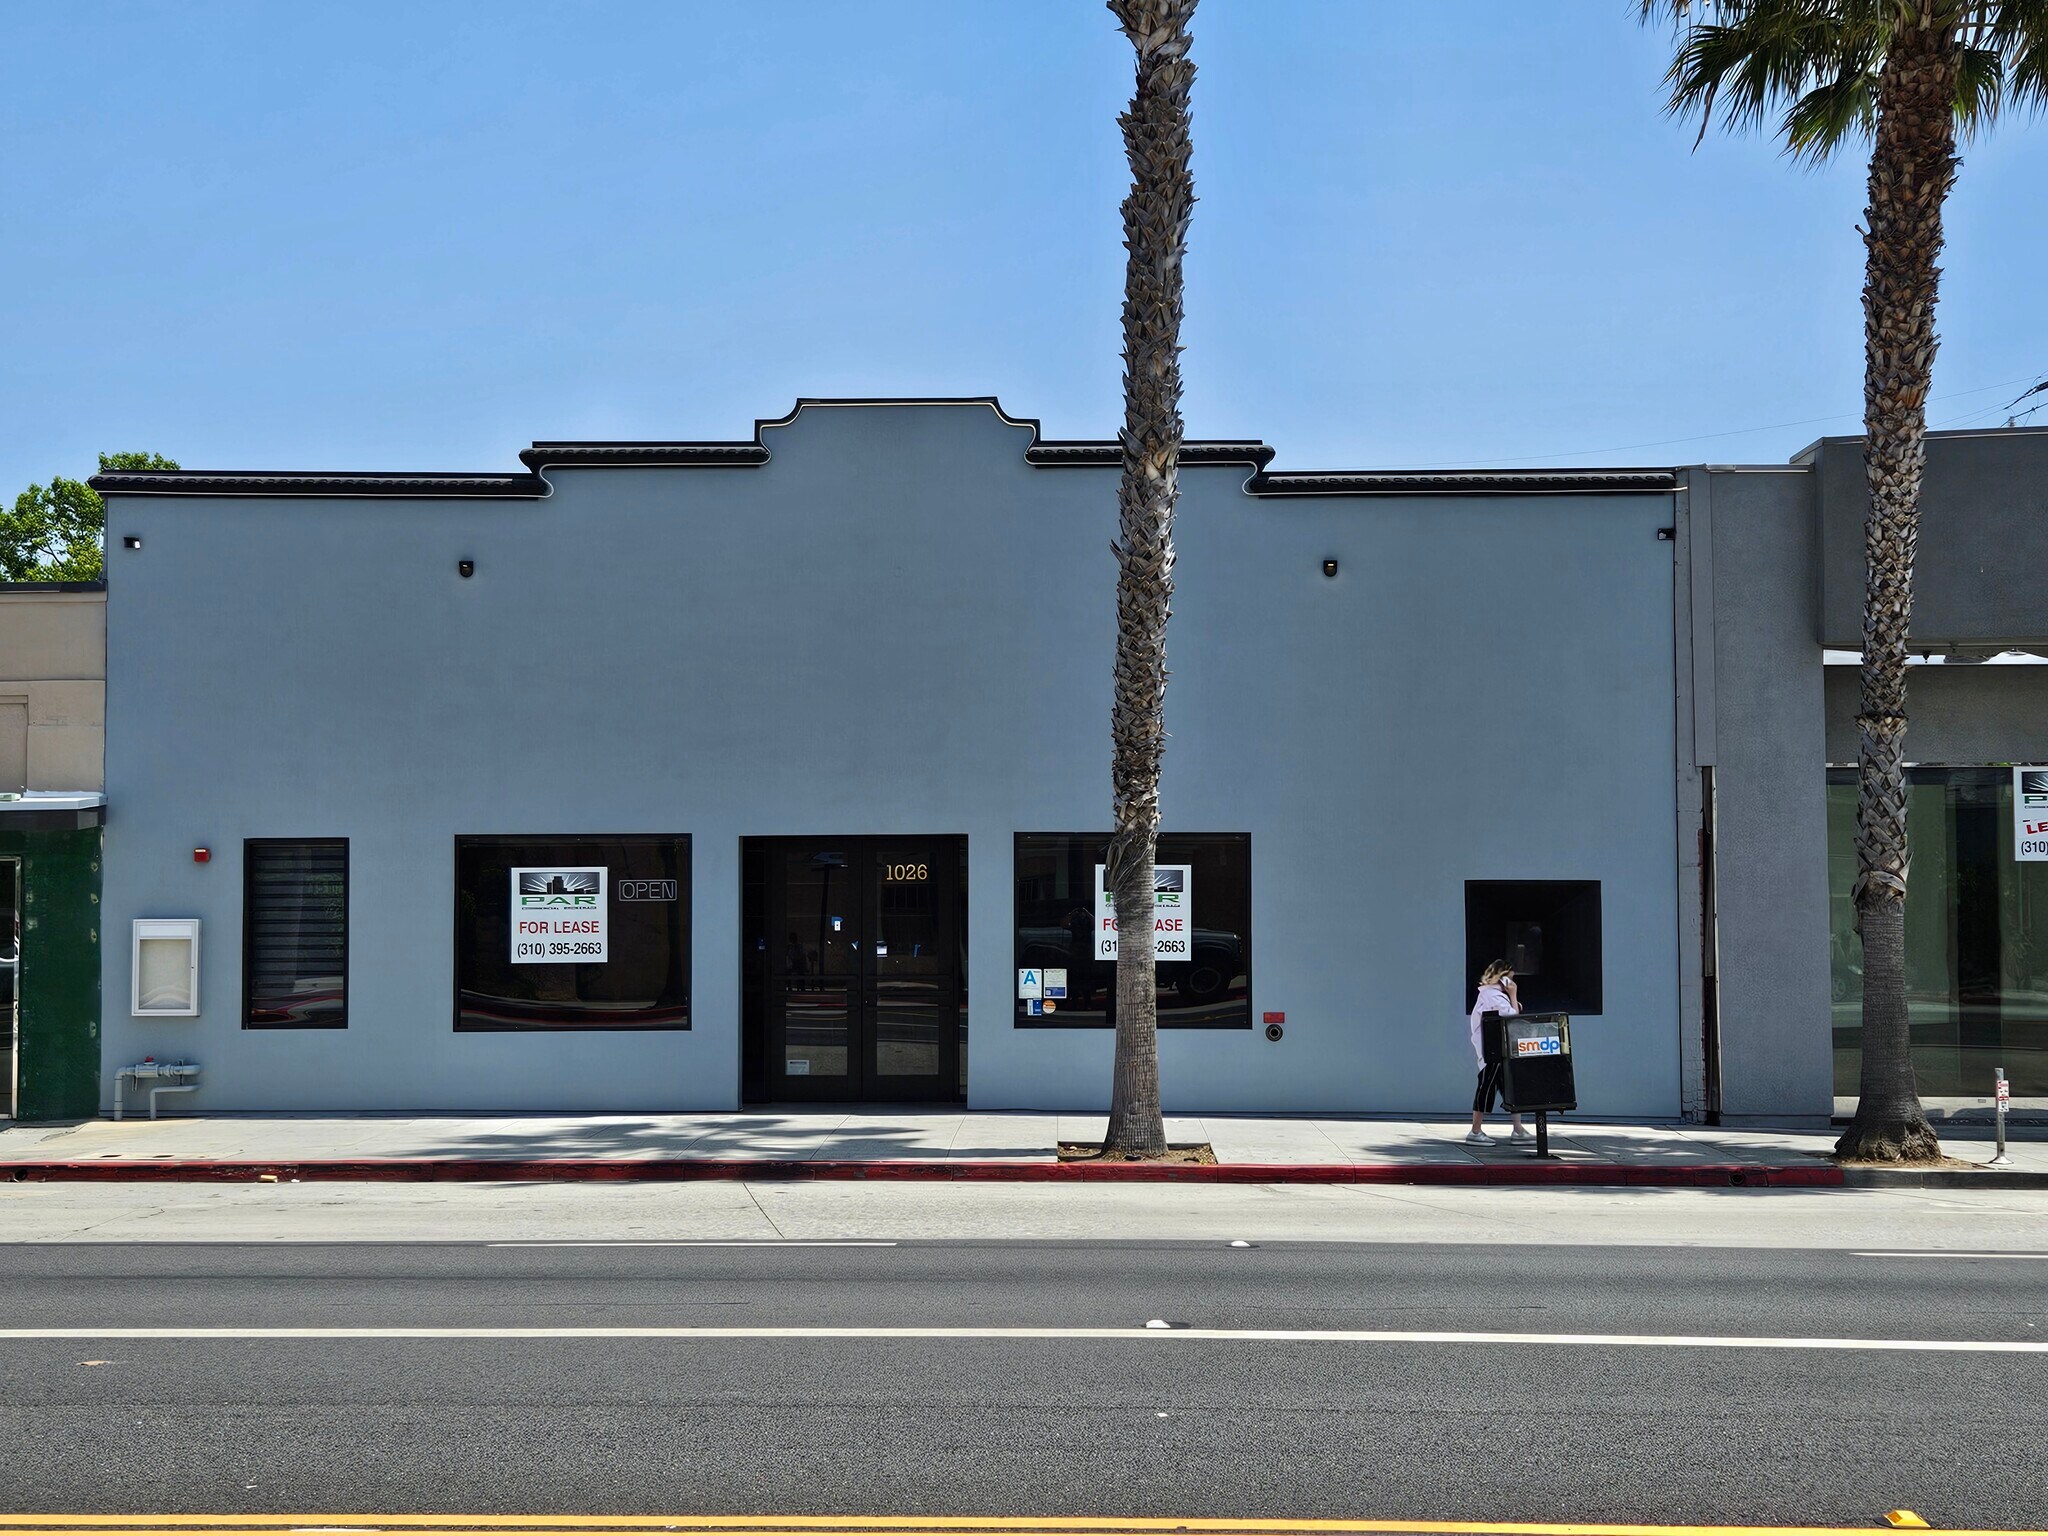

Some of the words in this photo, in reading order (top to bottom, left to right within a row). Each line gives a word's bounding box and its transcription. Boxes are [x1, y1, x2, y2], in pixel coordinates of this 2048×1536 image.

[886, 864, 928, 881] 1026
[621, 881, 674, 899] OPEN
[521, 896, 596, 905] PAR
[519, 921, 549, 934] FOR
[554, 921, 600, 934] LEASE
[1154, 918, 1183, 932] ASE
[517, 942, 546, 958] (310)
[549, 942, 602, 955] 395-2663
[1154, 940, 1186, 953] -2663
[1023, 970, 1037, 985] A
[1518, 1036, 1560, 1054] smdp
